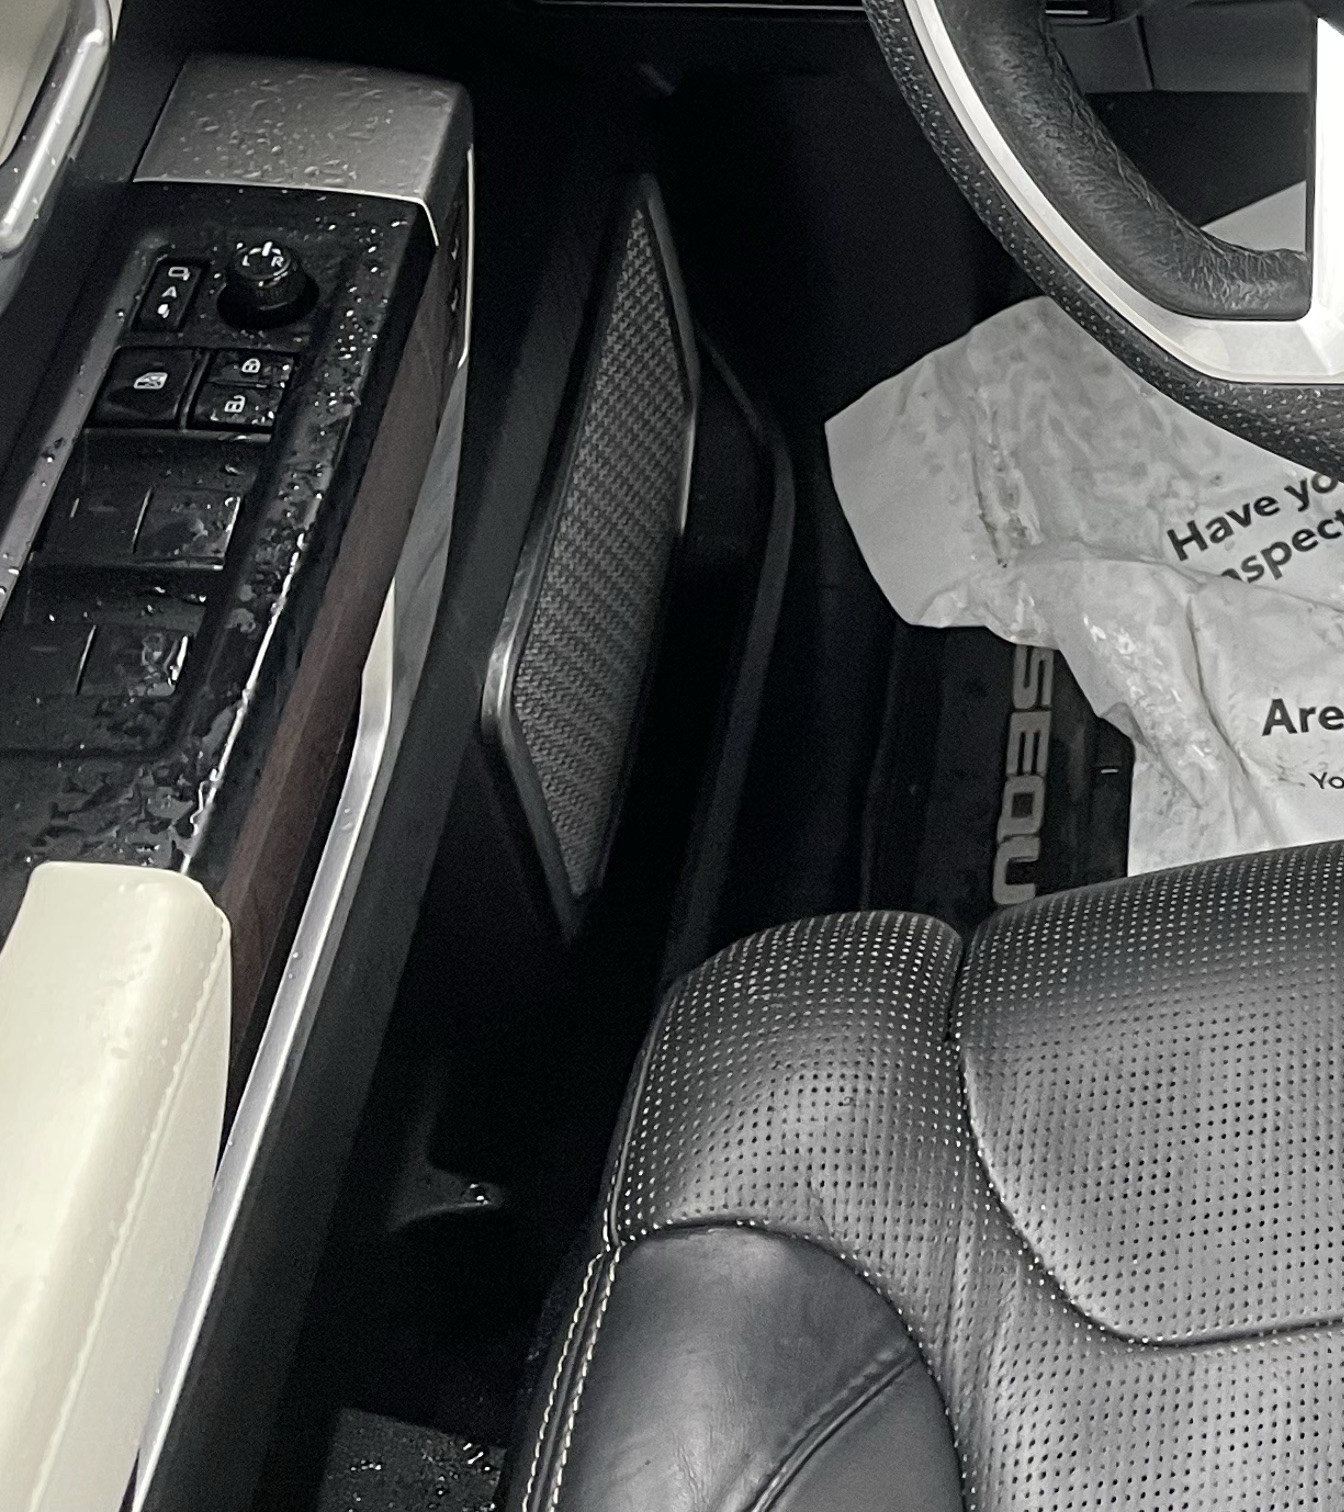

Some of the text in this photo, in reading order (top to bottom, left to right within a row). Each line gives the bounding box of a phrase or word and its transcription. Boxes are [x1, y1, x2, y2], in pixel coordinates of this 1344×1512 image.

[271, 255, 284, 267] R
[1166, 472, 1340, 563] Have yo
